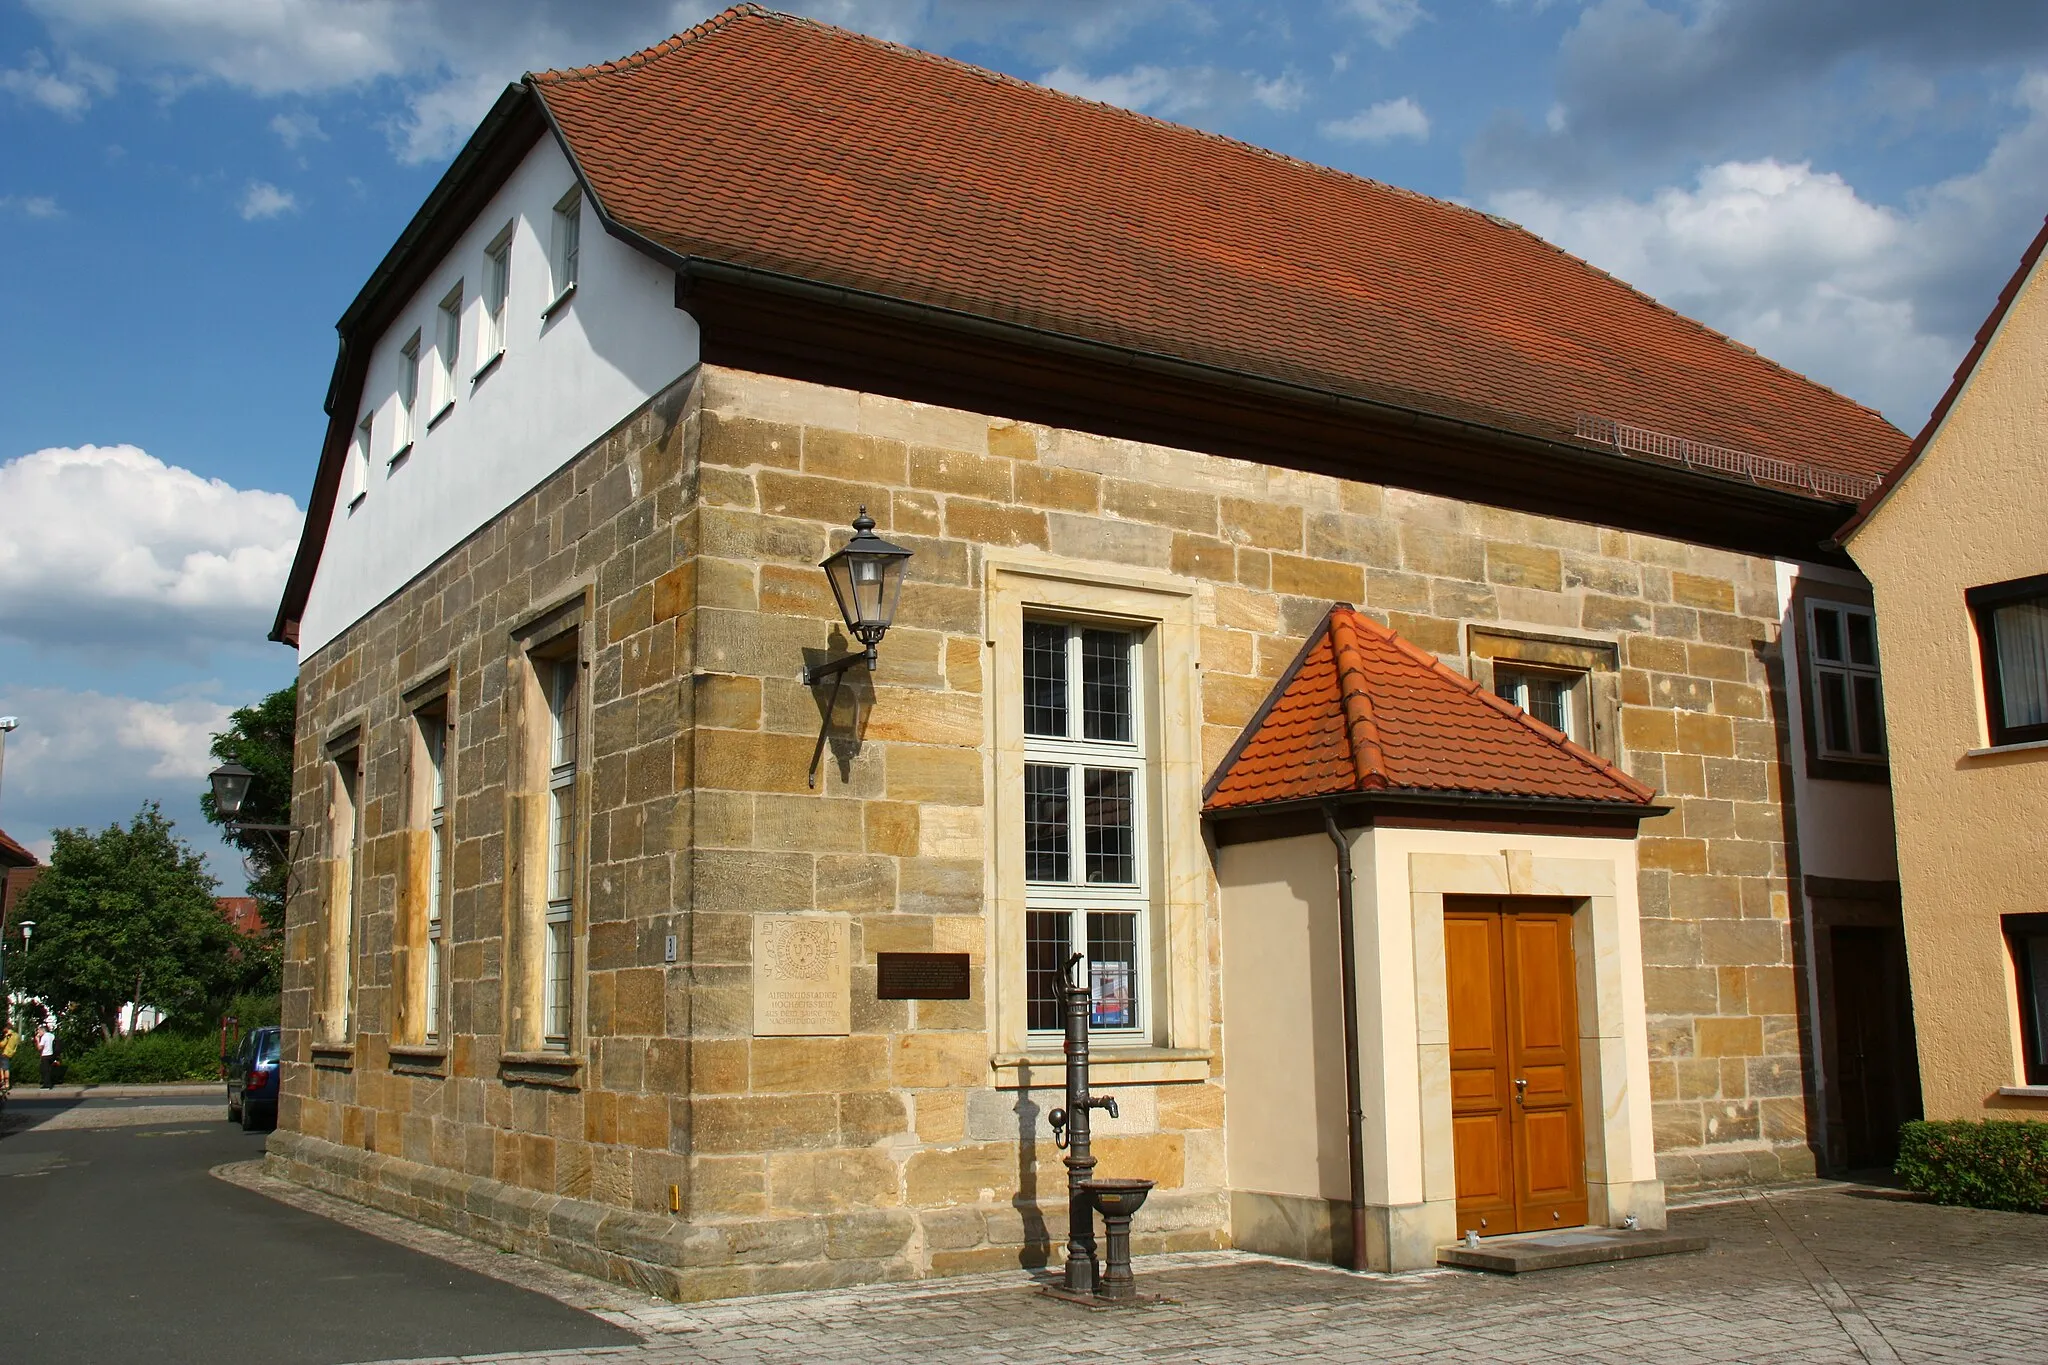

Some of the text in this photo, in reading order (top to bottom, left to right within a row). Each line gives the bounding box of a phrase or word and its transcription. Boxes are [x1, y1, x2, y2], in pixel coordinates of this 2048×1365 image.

[668, 937, 673, 953] 3
[772, 1000, 834, 1009] HOCHZEITSSTEIN
[799, 1010, 822, 1018] JAHRE
[769, 1017, 816, 1025] NACHBILDUNG
